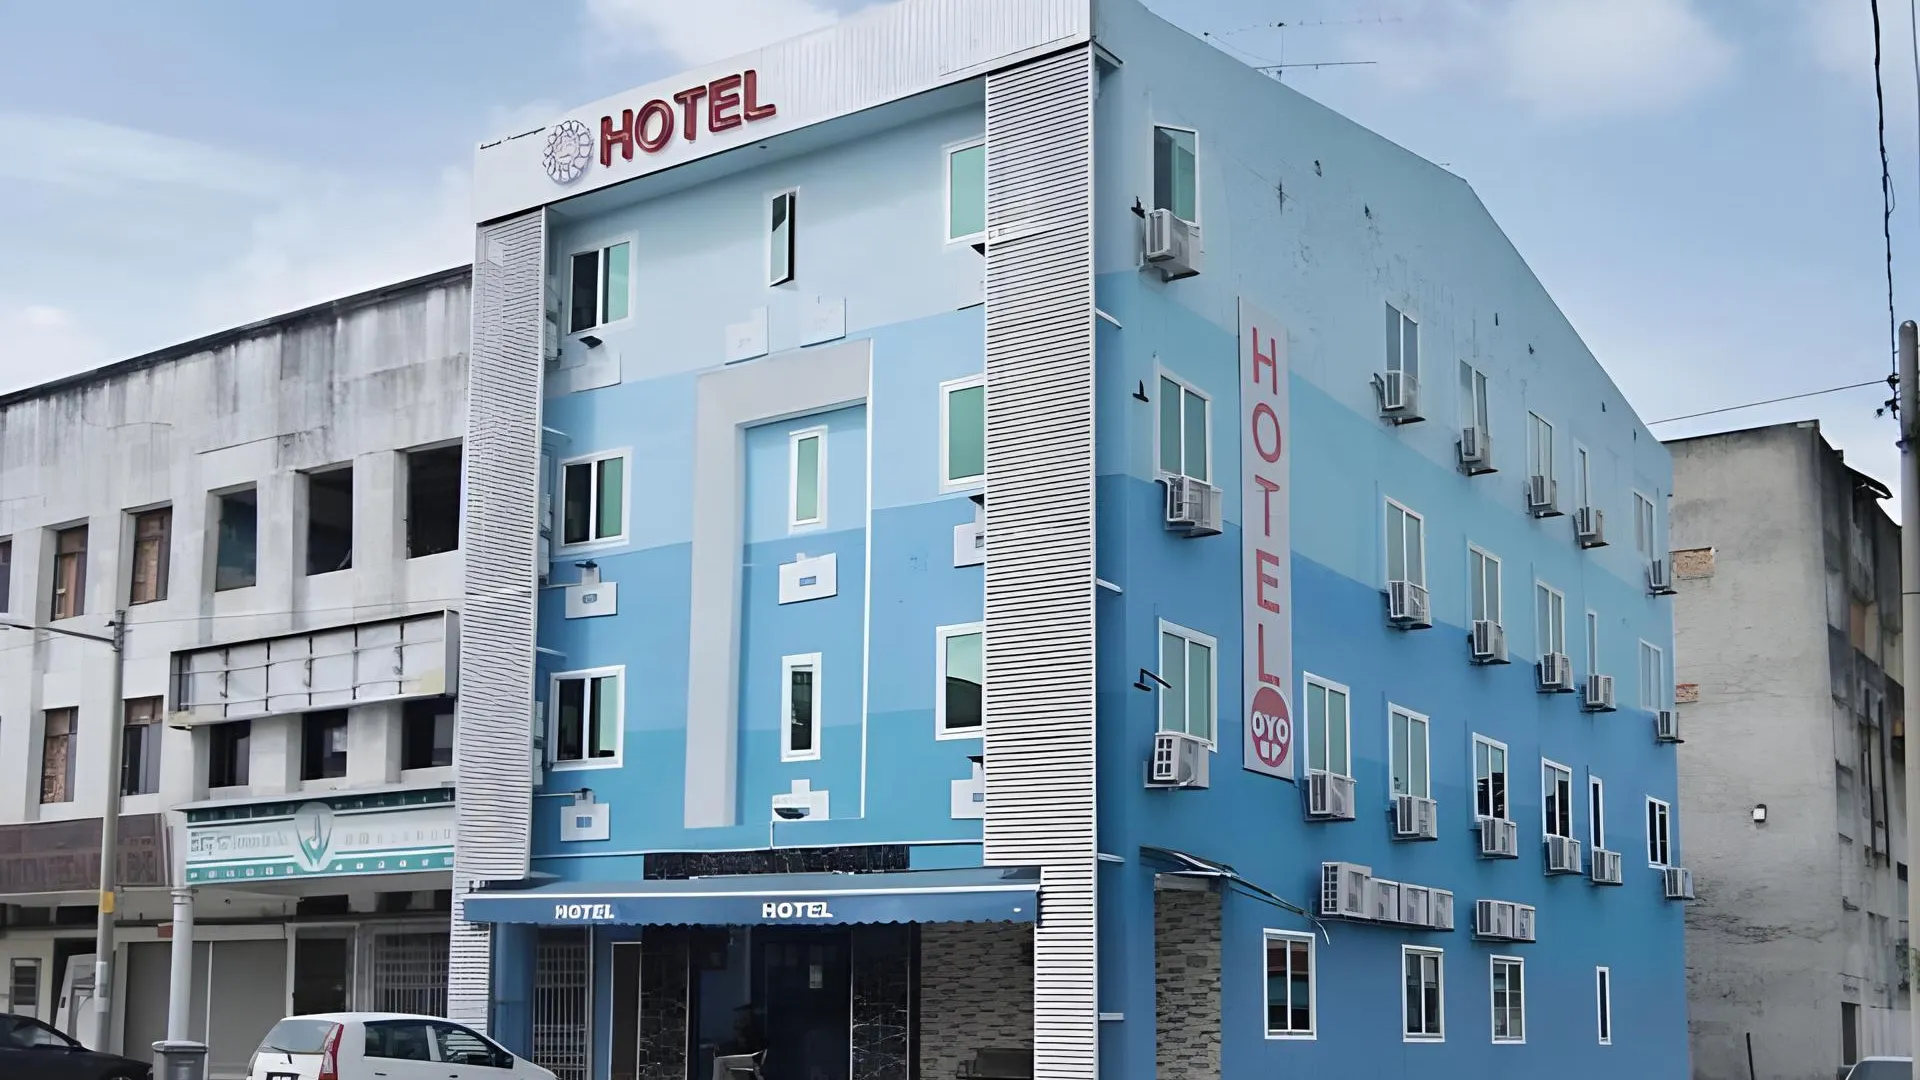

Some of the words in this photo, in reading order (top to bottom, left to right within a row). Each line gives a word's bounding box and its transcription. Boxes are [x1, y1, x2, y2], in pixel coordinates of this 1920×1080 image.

[600, 69, 777, 168] HOTEL
[1252, 326, 1281, 687] HOTEL
[1252, 710, 1289, 745] OYO
[762, 901, 834, 919] HOTEL
